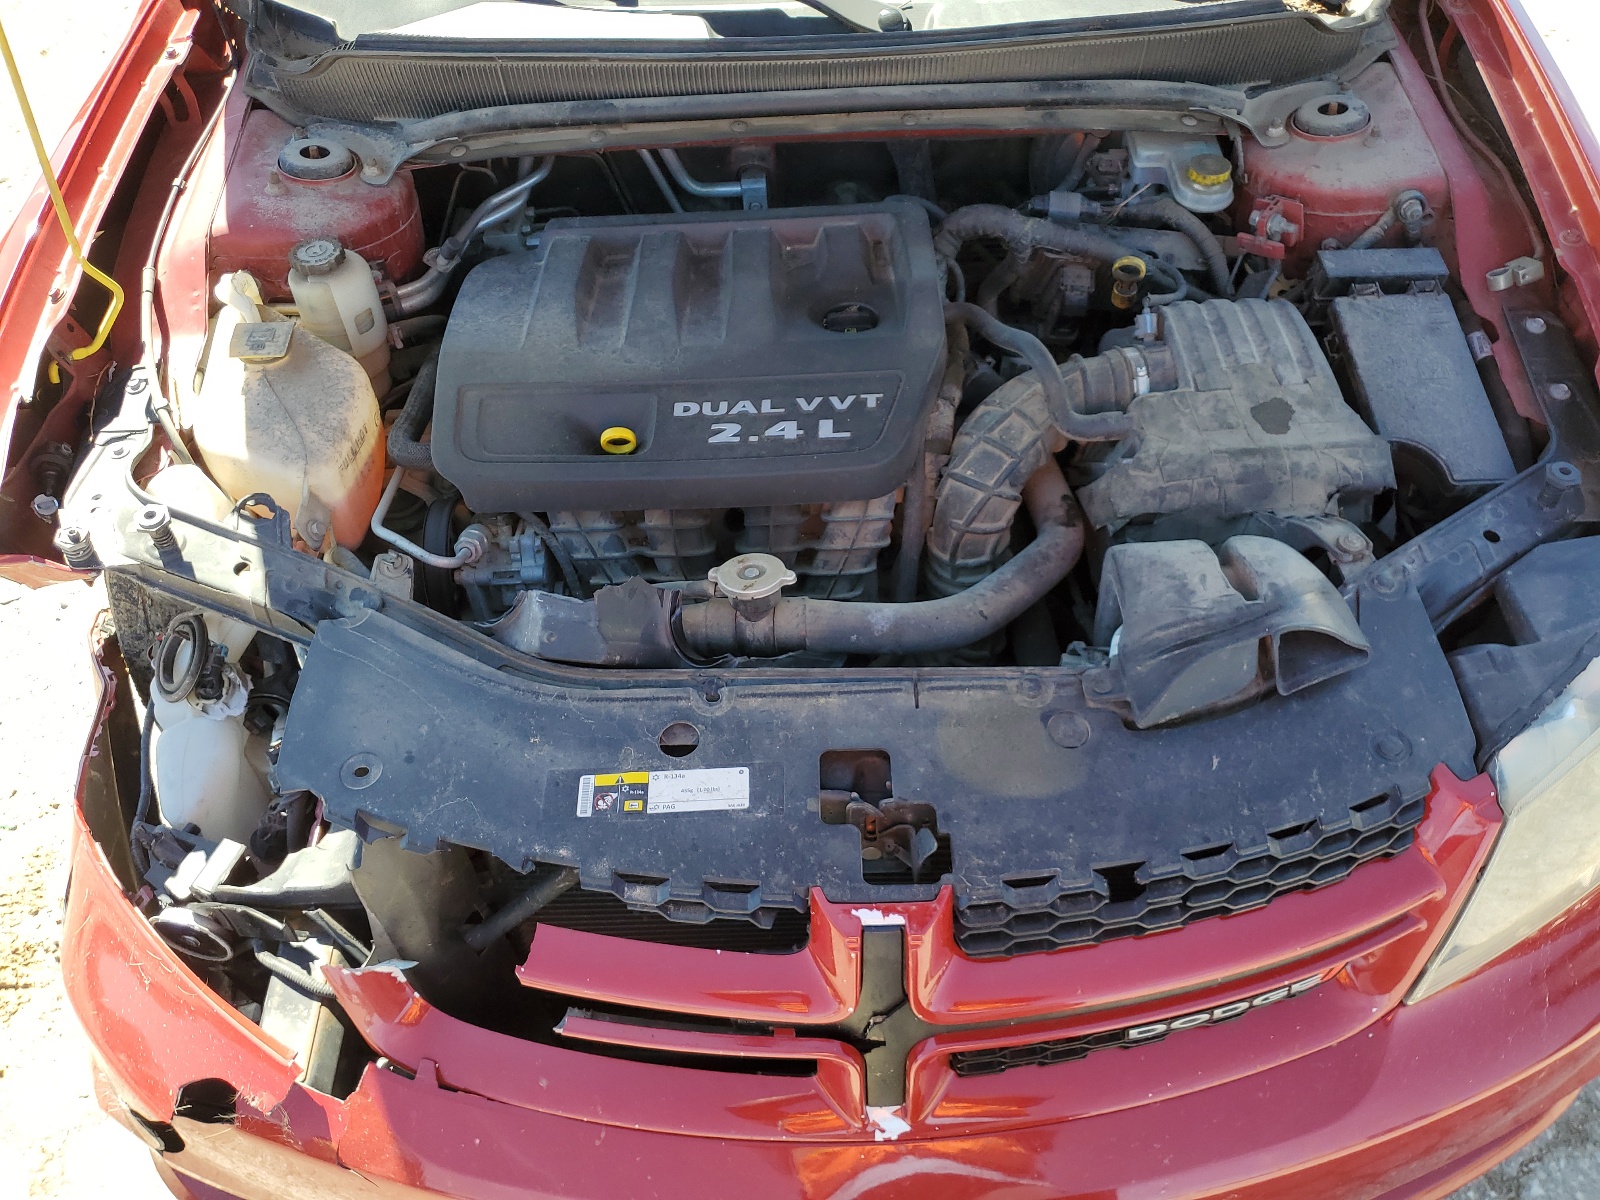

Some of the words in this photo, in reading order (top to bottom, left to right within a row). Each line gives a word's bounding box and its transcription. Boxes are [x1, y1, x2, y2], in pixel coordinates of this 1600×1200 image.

[673, 399, 785, 417] DUAL
[796, 393, 884, 411] VVT
[1128, 973, 1324, 1040] DODGE
